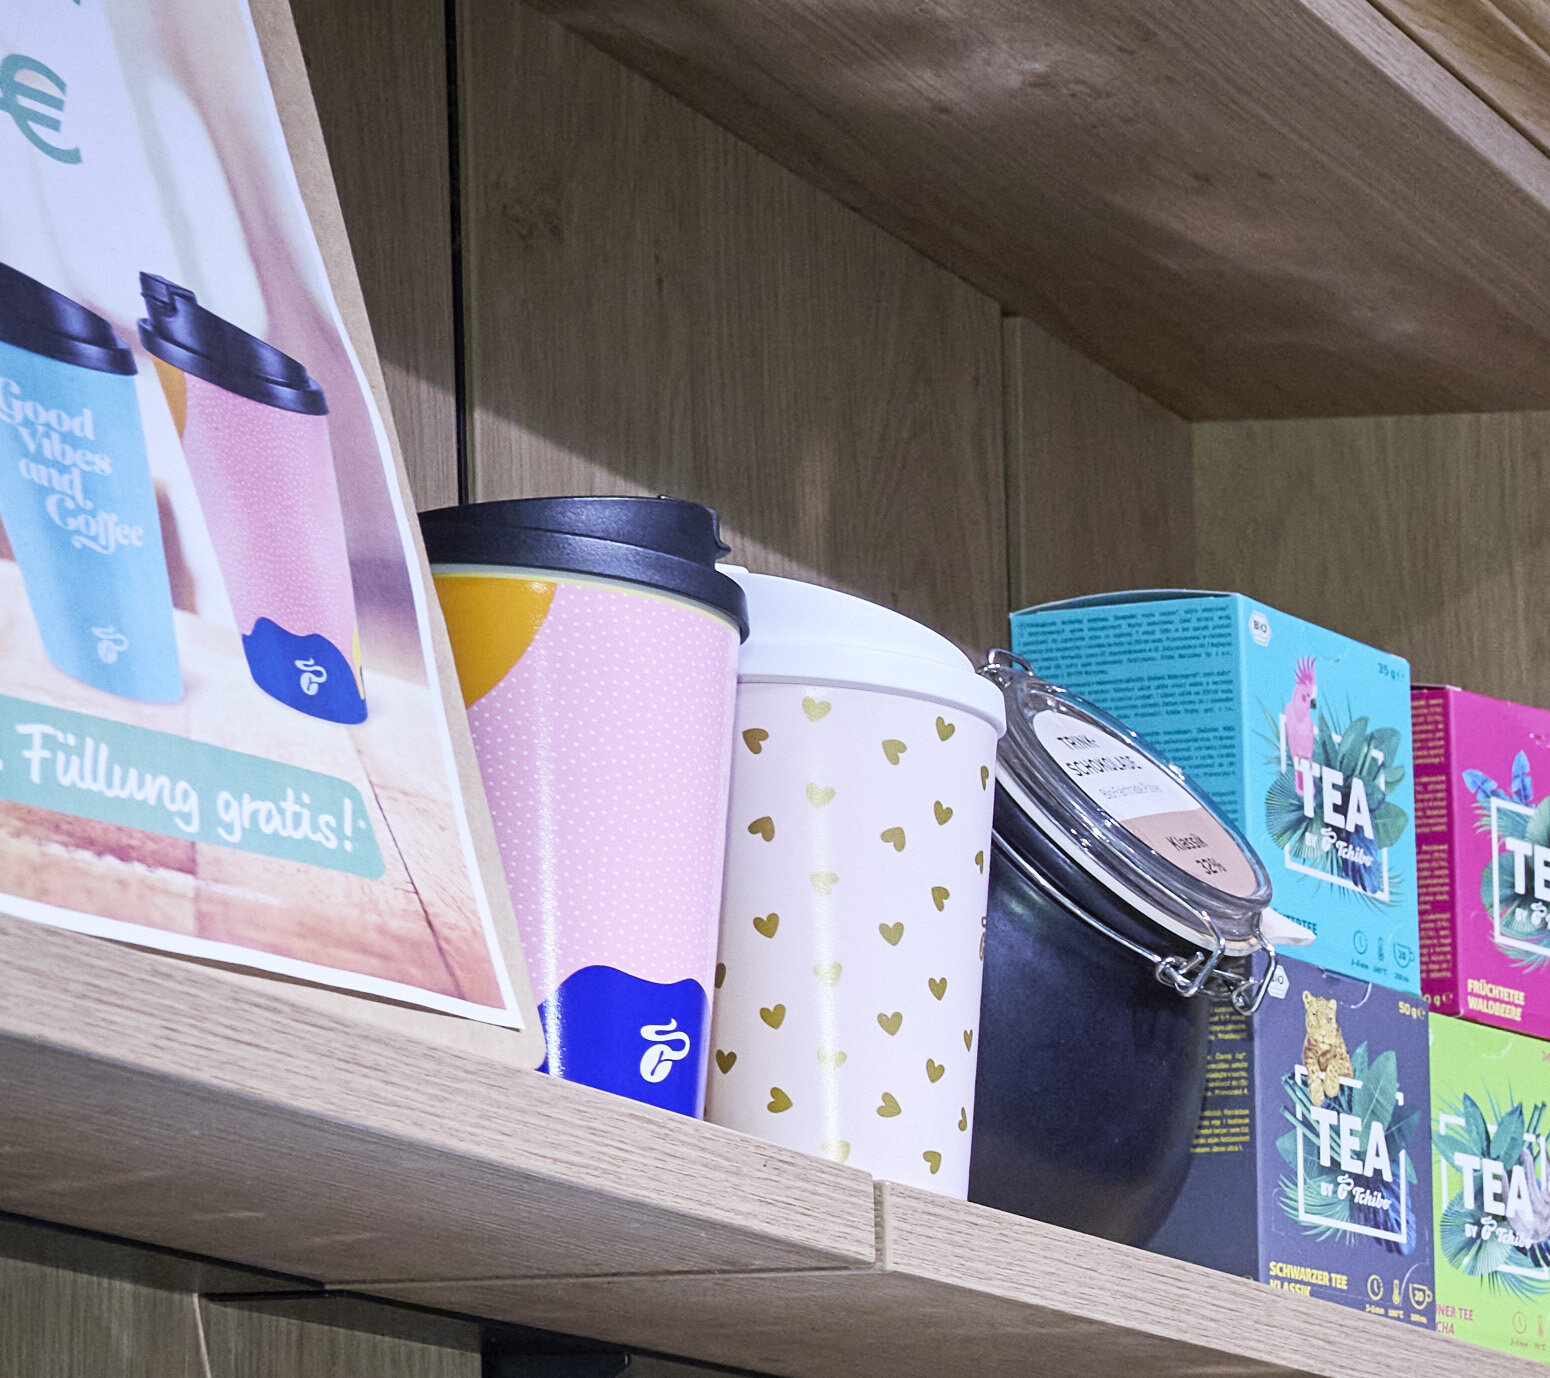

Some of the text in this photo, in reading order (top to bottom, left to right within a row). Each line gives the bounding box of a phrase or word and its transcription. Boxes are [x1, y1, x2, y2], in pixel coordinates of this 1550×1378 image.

[0, 376, 95, 440] Good
[17, 424, 112, 475] Vibes
[19, 458, 94, 510] and
[46, 493, 144, 554] Coffee
[1057, 735, 1100, 752] TRINK-
[1066, 755, 1143, 777] SCHOKOLADE
[15, 724, 353, 852] Füllung gratis!
[1294, 756, 1375, 840] TEA
[1166, 833, 1209, 851] Klassik
[1336, 840, 1375, 867] Tchibo
[1196, 858, 1227, 875] 32%
[1467, 978, 1526, 1006] FRÜCHTETEE
[1467, 995, 1523, 1022] WALDBEERE
[1310, 1105, 1393, 1182] TEA
[1320, 1181, 1392, 1211] BY Tchibo
[1454, 1152, 1534, 1222] TEA
[1465, 1223, 1478, 1238] BY
[1269, 1261, 1348, 1290] SCHWARZER TEE
[1458, 1307, 1473, 1321] TEE
